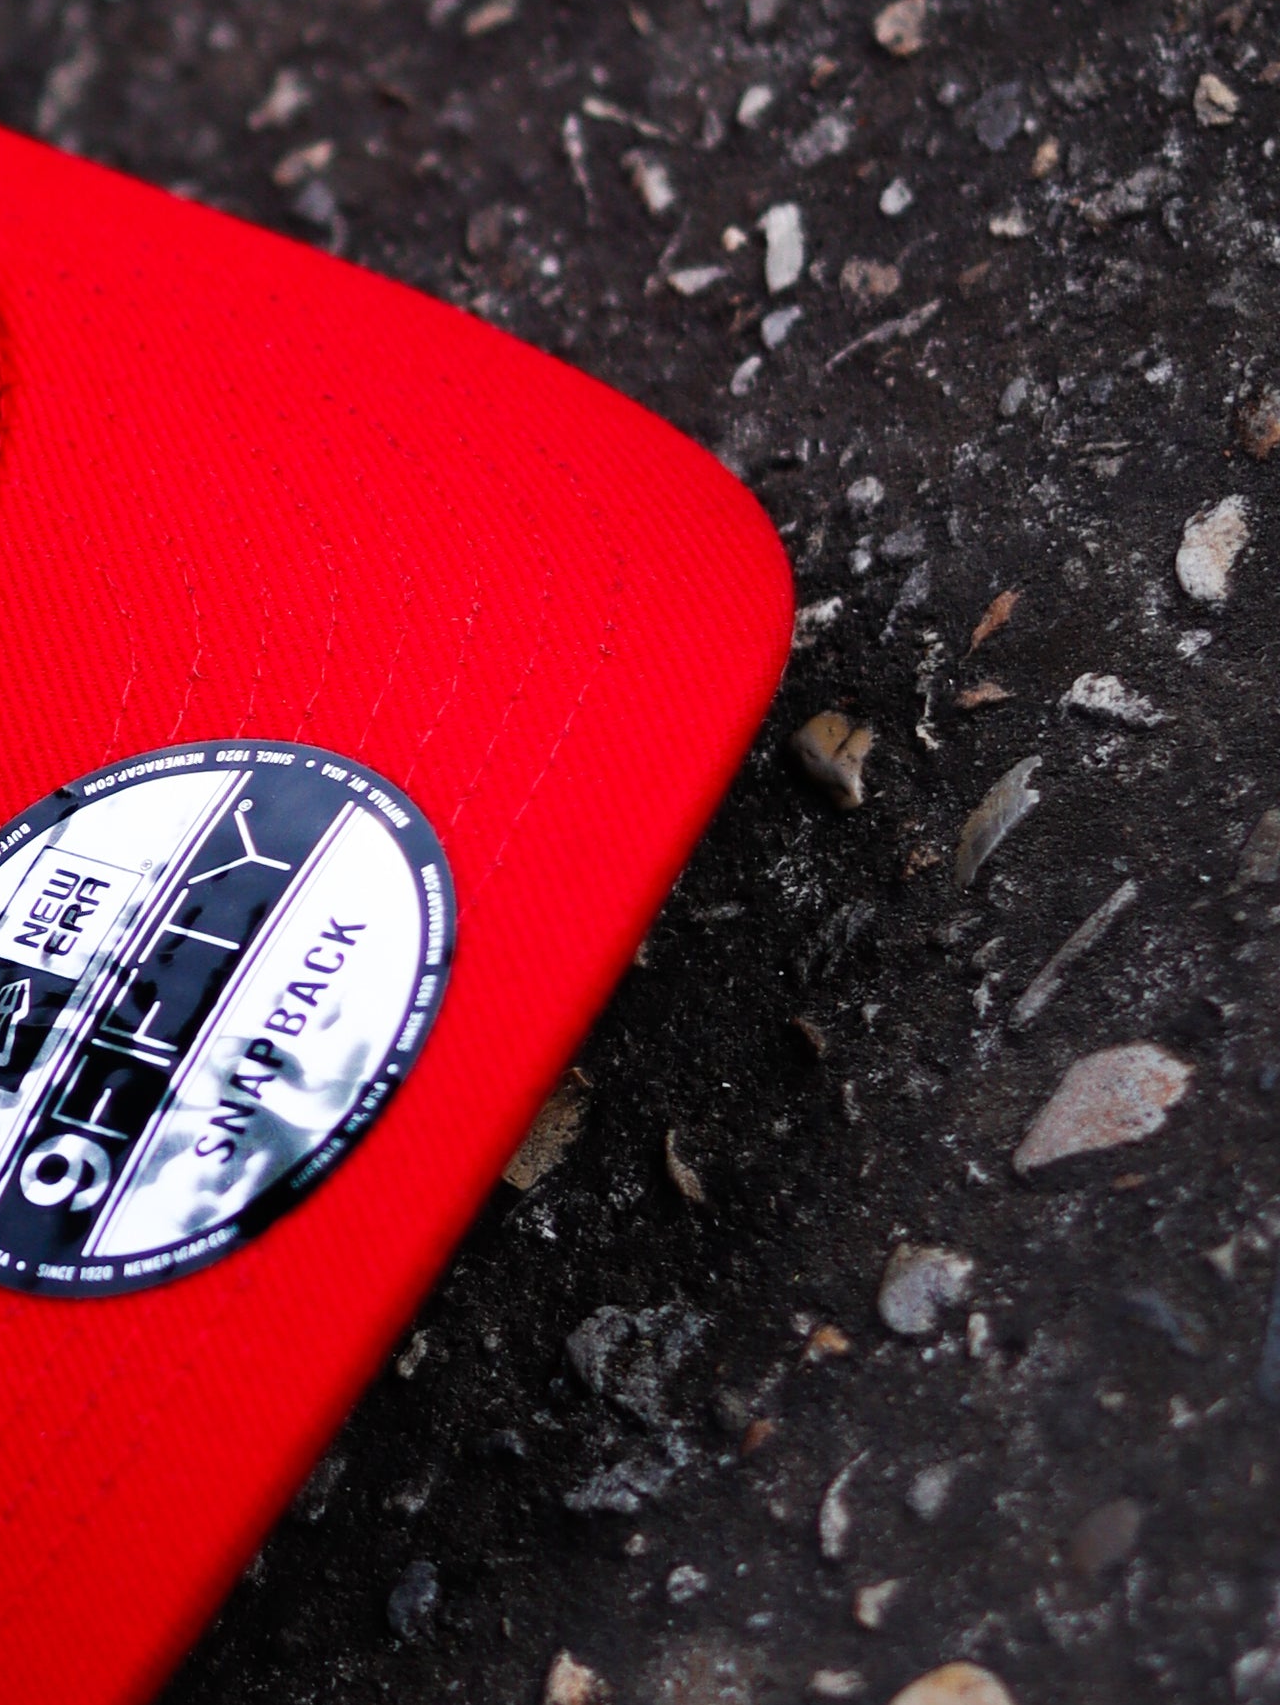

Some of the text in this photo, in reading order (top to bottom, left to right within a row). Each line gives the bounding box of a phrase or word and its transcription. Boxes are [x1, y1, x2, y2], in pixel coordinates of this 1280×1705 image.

[83, 752, 205, 796] NEWERACAP.COM
[216, 750, 250, 762] 1920
[256, 750, 296, 765] SINCE
[321, 762, 348, 782] USA
[13, 868, 81, 949] NEW
[43, 877, 111, 956] ERA
[195, 916, 368, 1164] SNAPBACK
